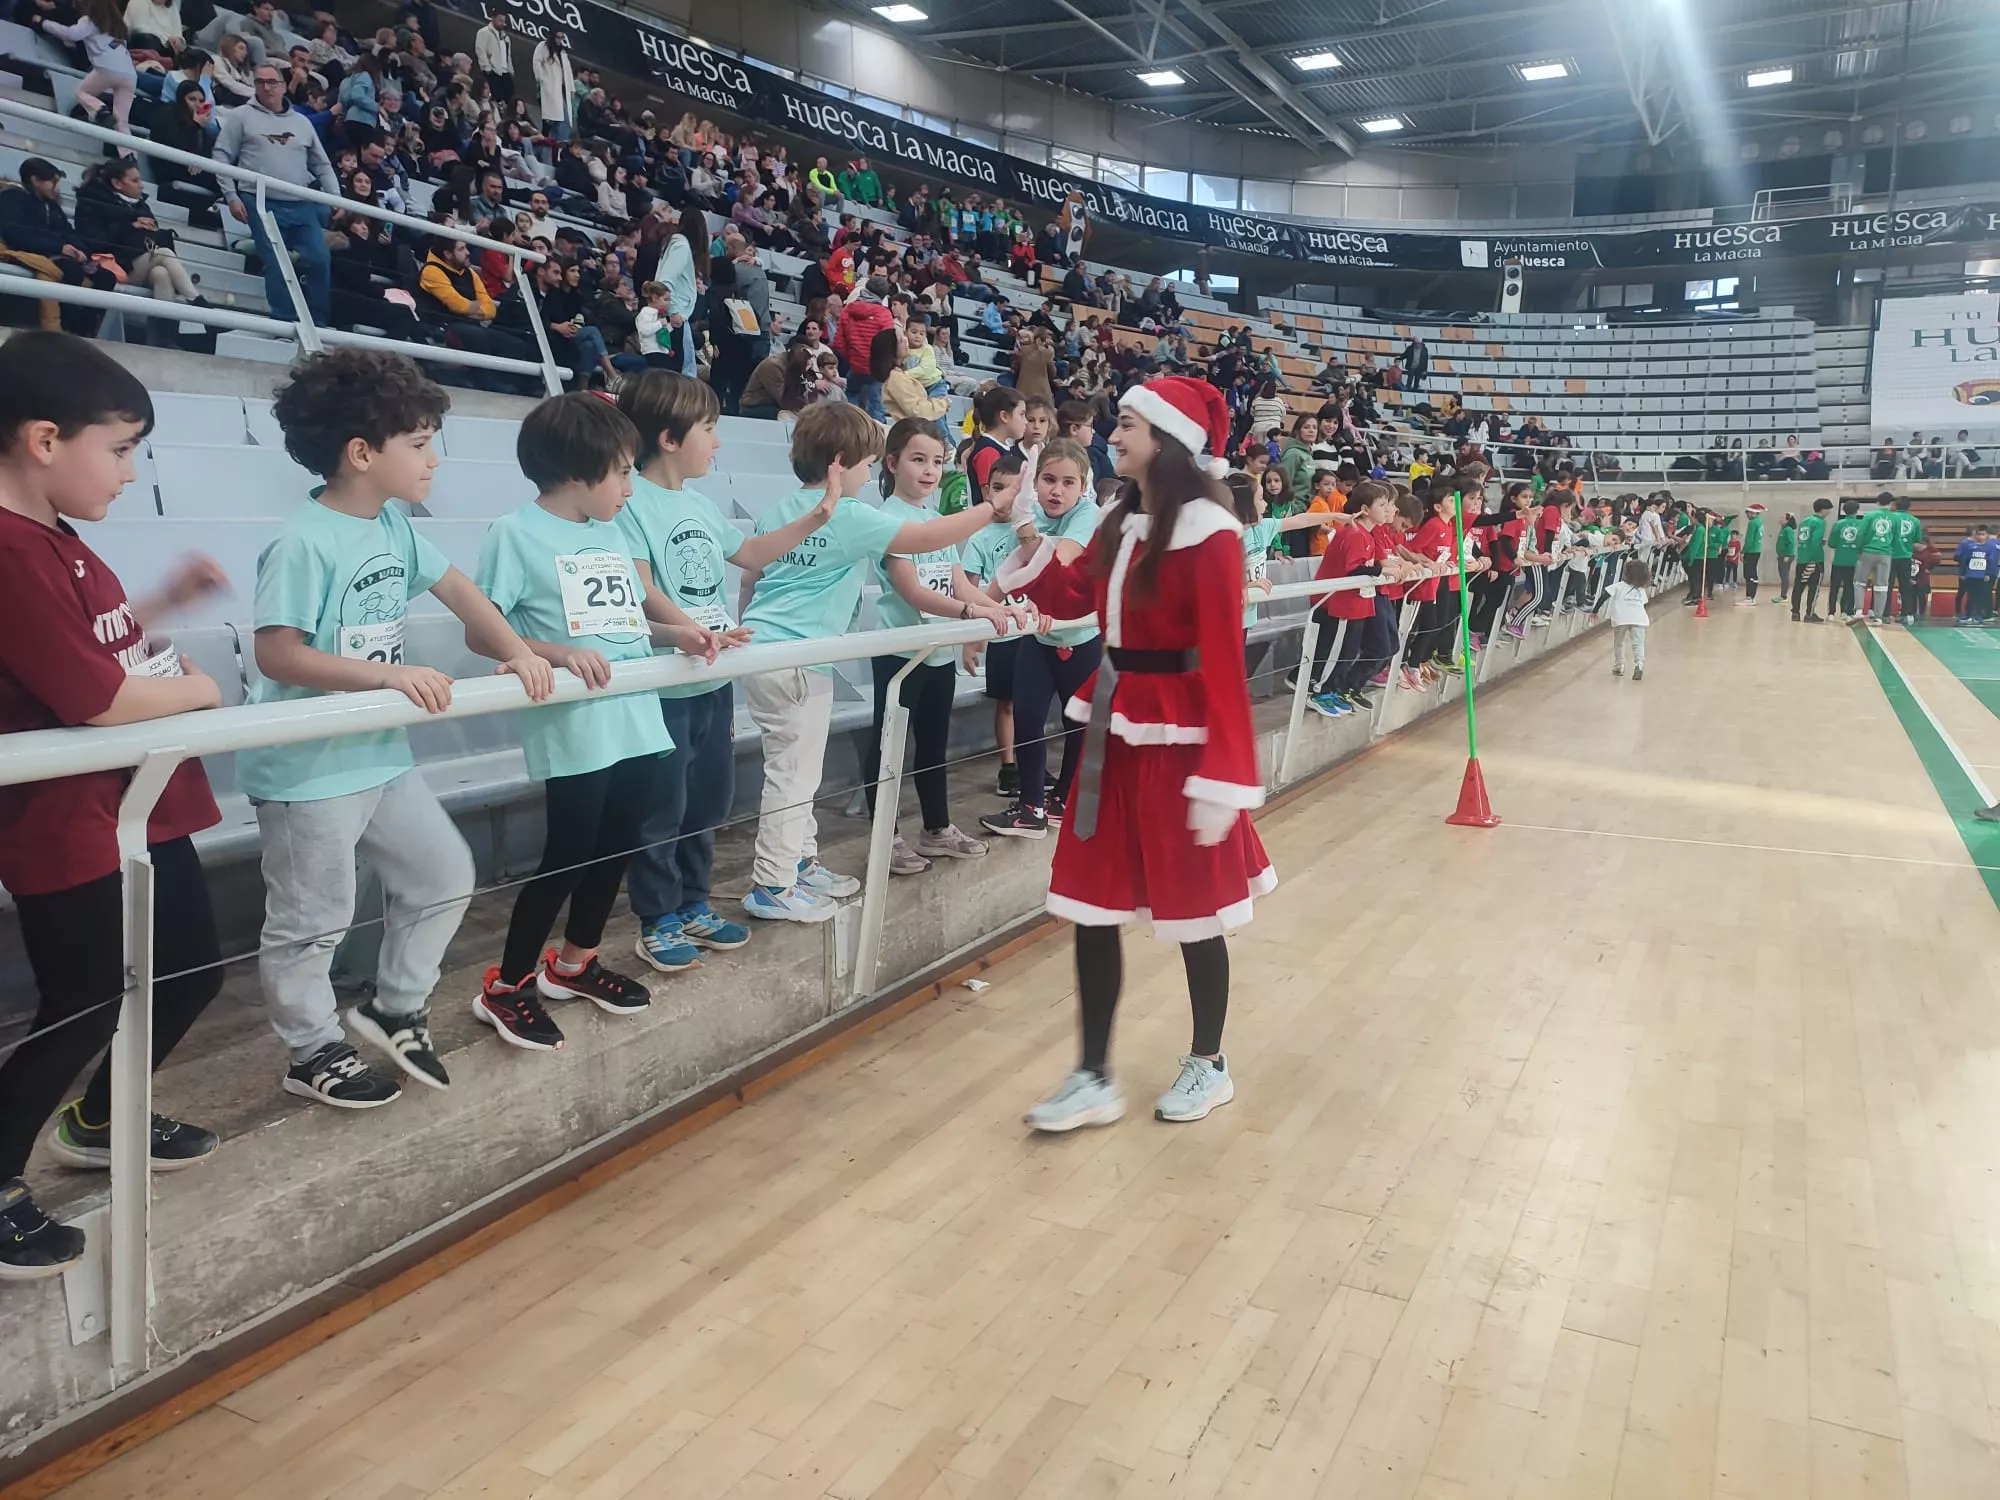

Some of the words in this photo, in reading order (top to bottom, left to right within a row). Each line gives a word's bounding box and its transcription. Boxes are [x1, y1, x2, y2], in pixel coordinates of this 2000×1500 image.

[636, 29, 754, 94] Huesca
[782, 94, 889, 152] Huesca
[1208, 212, 1279, 242] Huesca
[1673, 225, 1782, 250] Huesca
[1829, 210, 1949, 238] Huesca
[1308, 231, 1390, 254] Huesca
[1493, 240, 1589, 256] Ayuntamiento
[583, 575, 637, 607] 251
